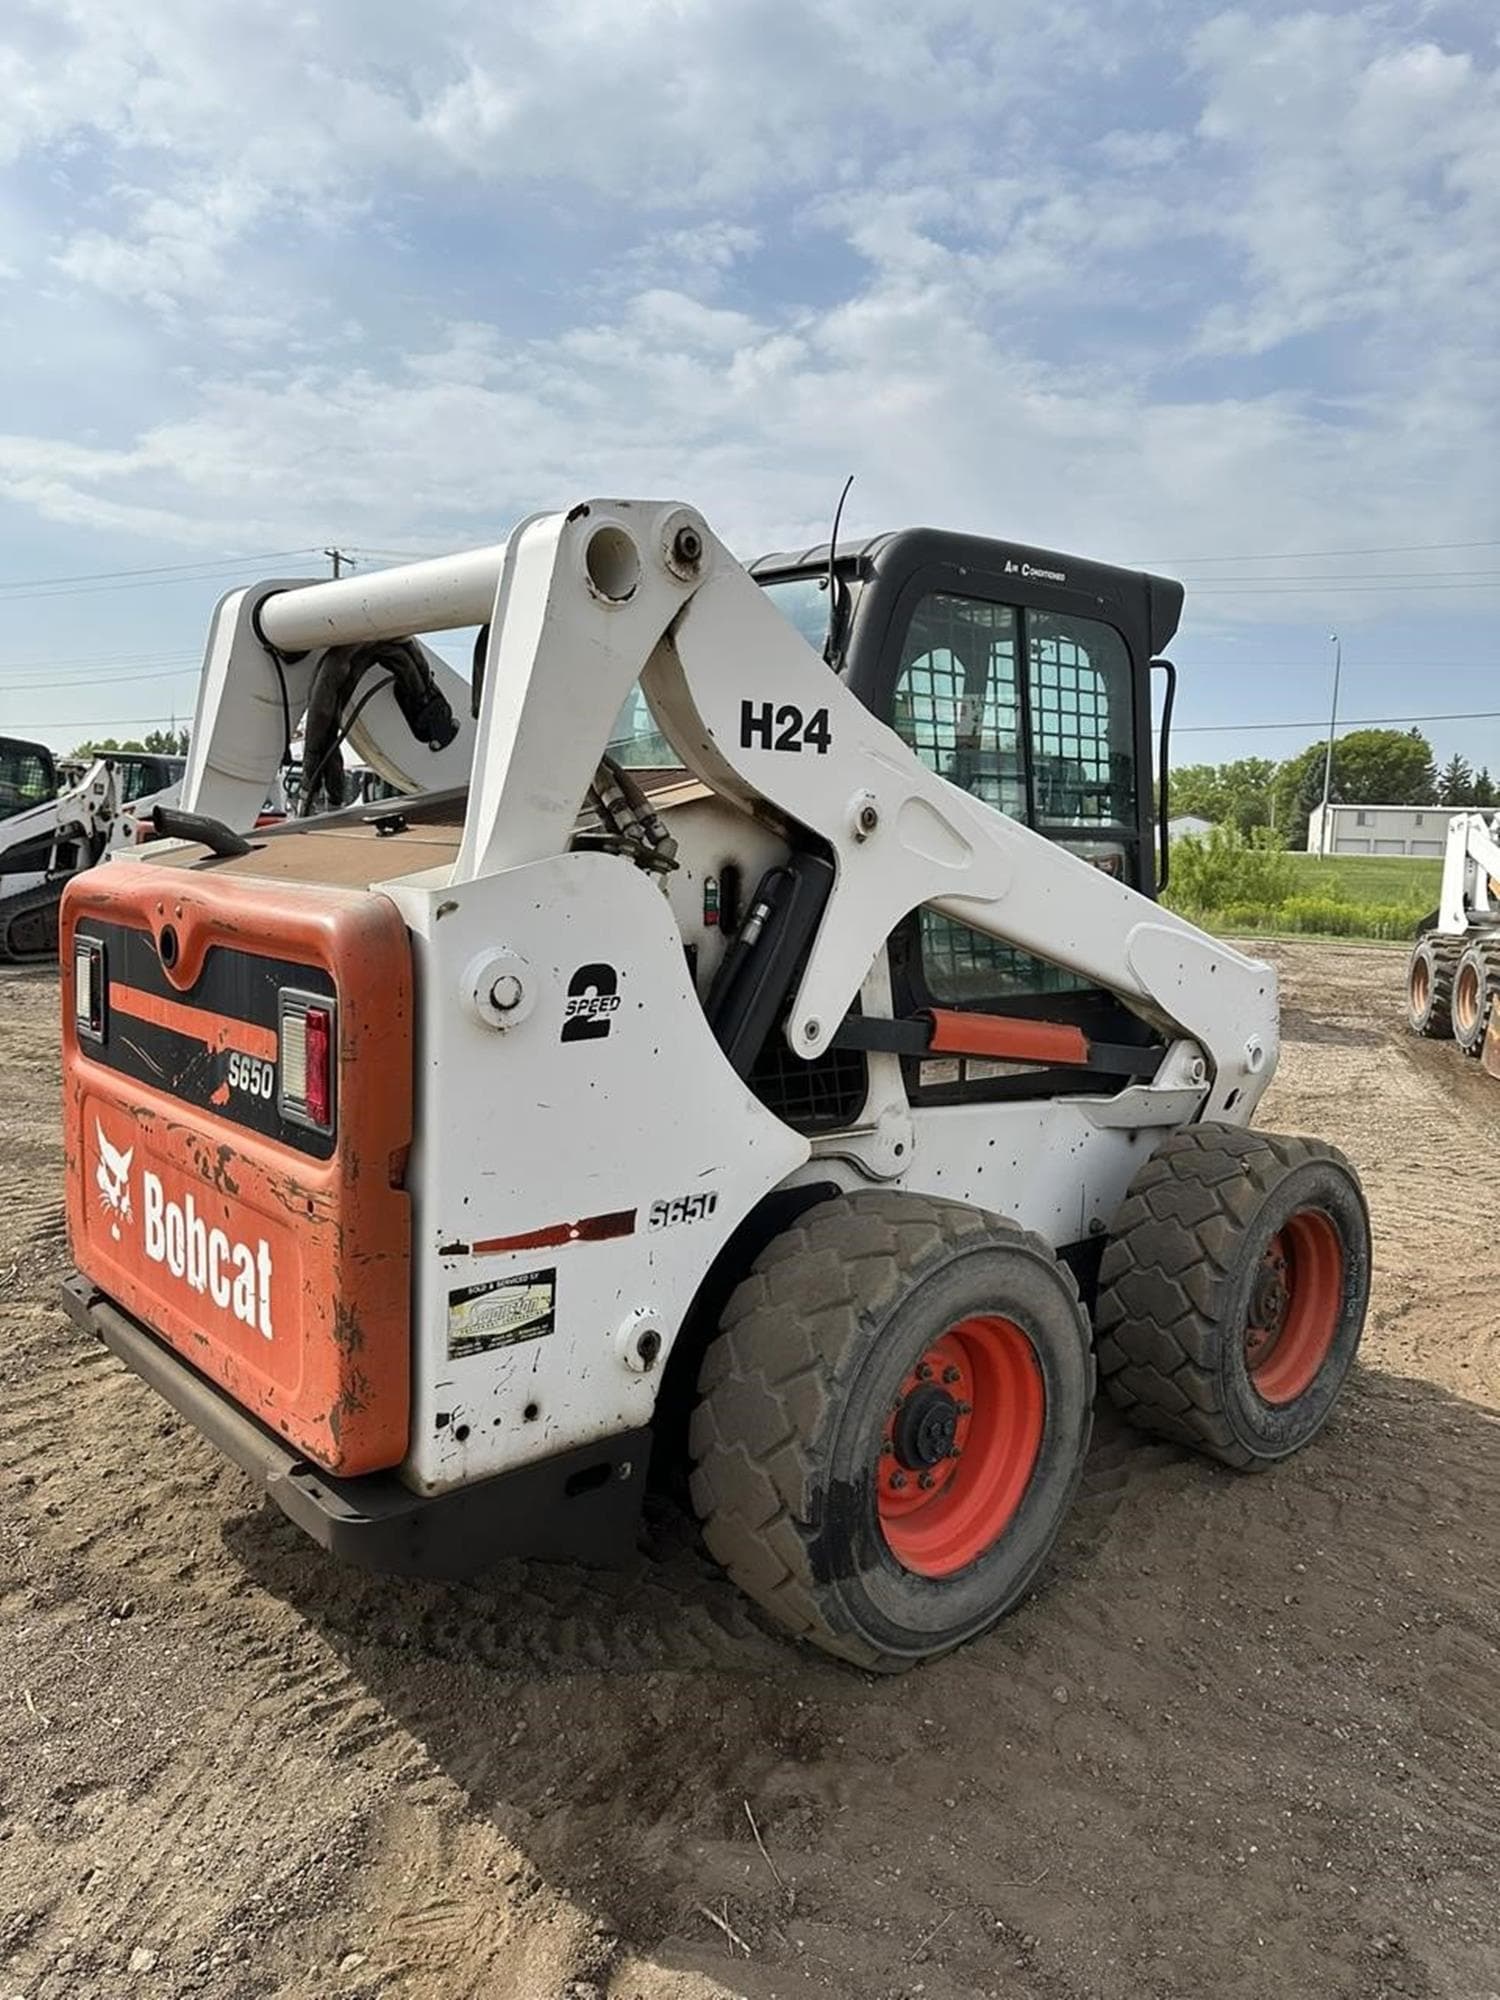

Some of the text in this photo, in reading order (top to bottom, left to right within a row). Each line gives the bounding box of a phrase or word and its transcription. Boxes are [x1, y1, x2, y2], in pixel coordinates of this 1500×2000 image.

[741, 700, 831, 754] H24
[565, 996, 621, 1016] SPEED
[228, 1052, 274, 1099] S650
[648, 1191, 719, 1233] S650
[144, 1170, 273, 1340] Bobcat
